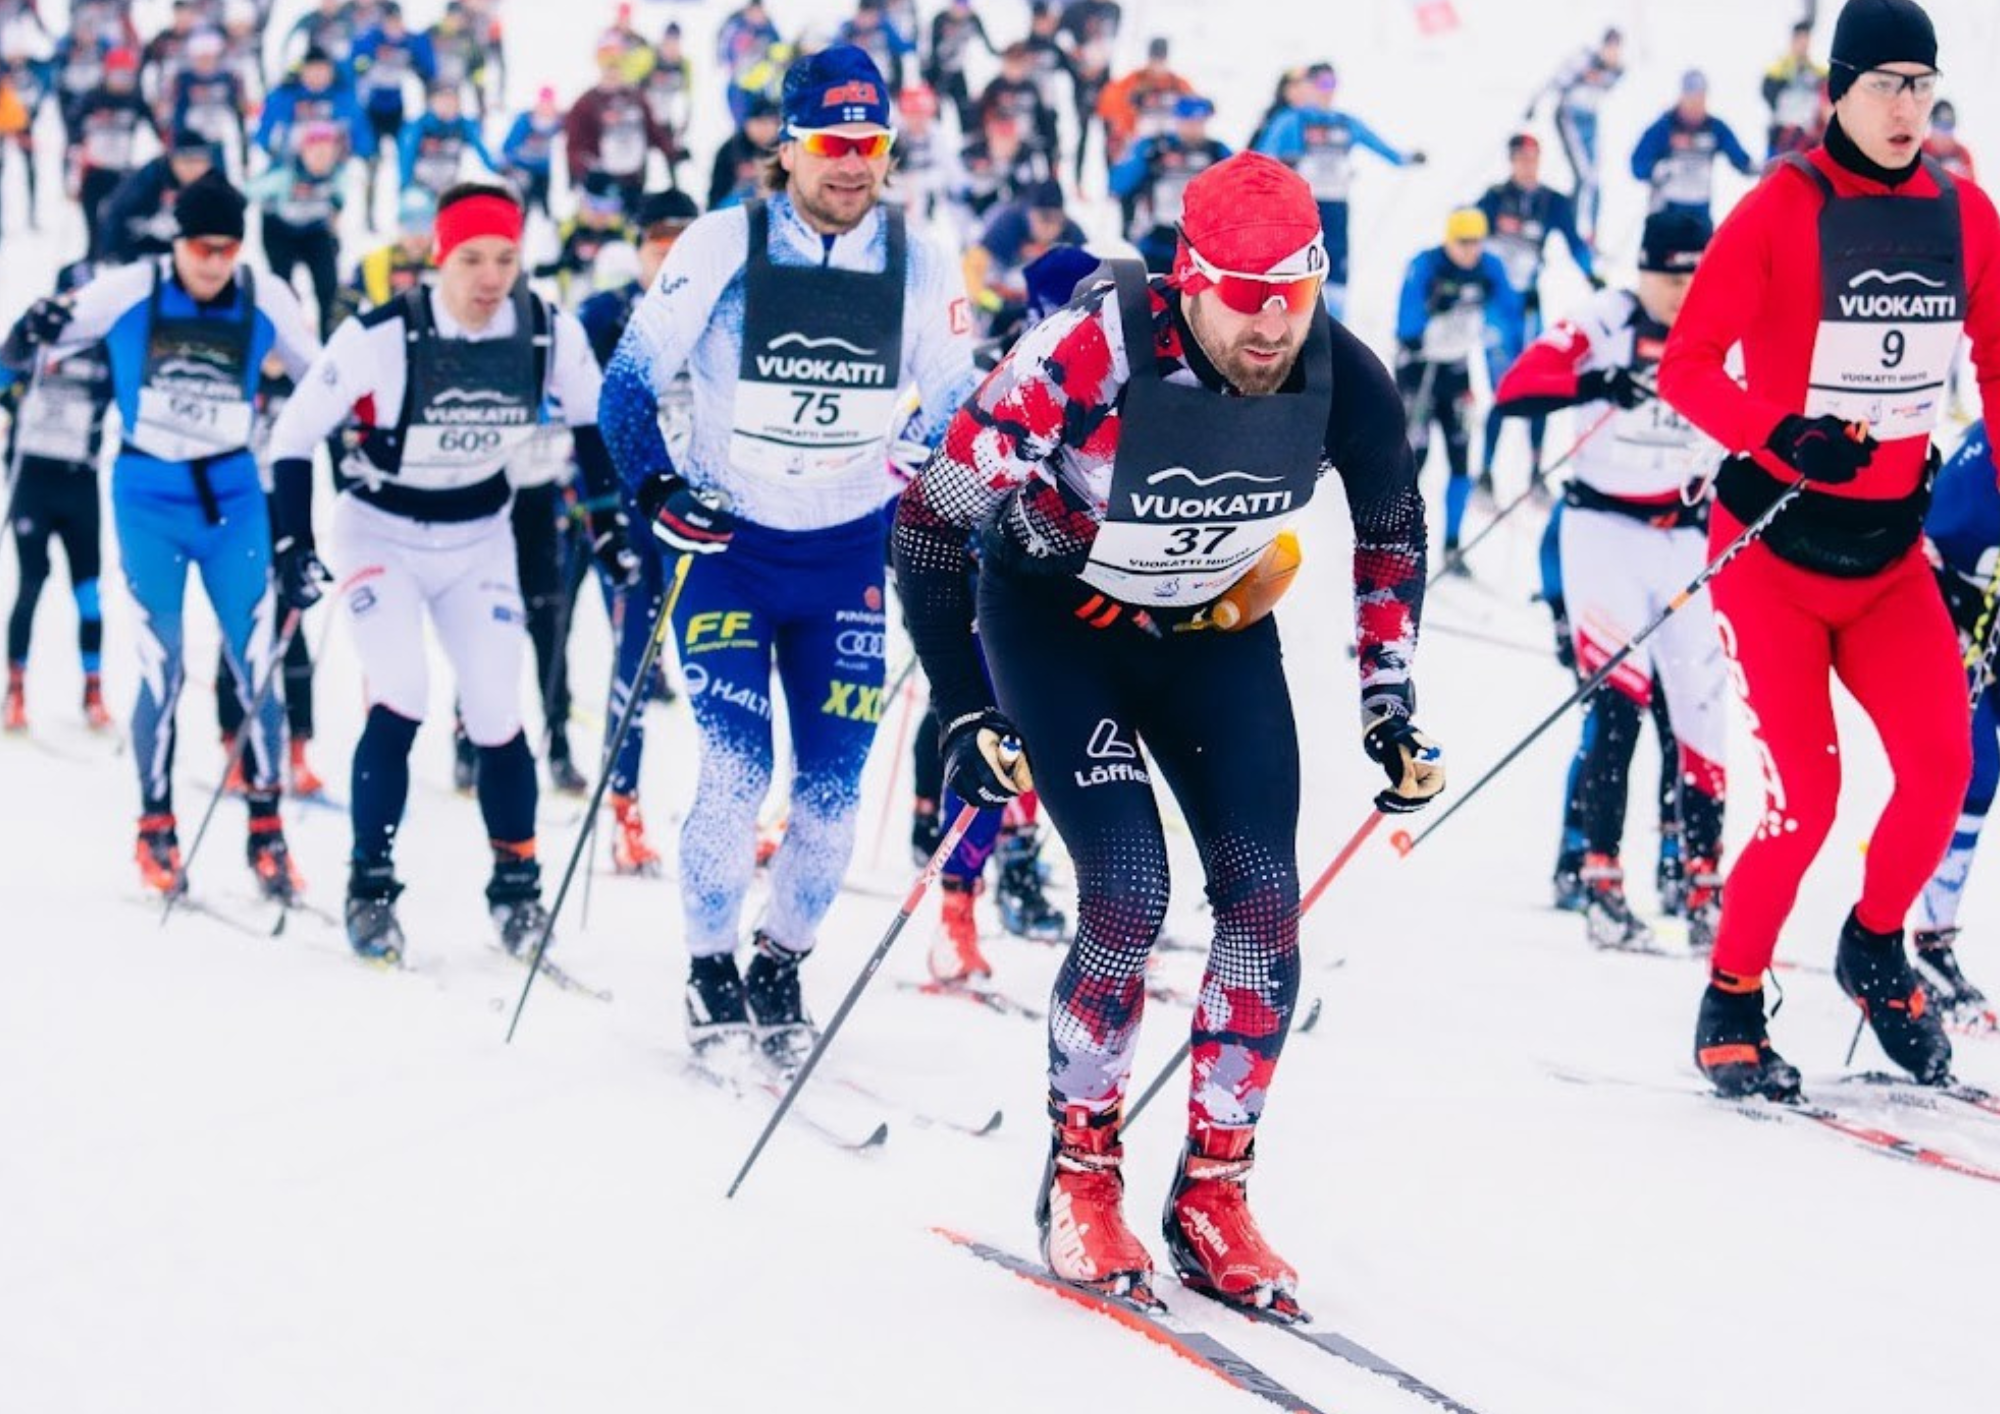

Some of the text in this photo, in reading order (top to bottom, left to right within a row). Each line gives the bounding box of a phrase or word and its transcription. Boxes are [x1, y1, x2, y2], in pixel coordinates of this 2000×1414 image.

[1839, 295, 1957, 318] VUOKATTI
[1881, 329, 1906, 369] 9
[755, 354, 886, 385] VUOKATTI
[423, 406, 528, 423] VUOKATTI
[790, 390, 842, 426] 75
[438, 430, 502, 454] 609
[1129, 490, 1293, 519] VUOKATTI
[1164, 526, 1238, 557] 37
[1129, 558, 1202, 569] VUOKATTI
[685, 611, 752, 646] FF
